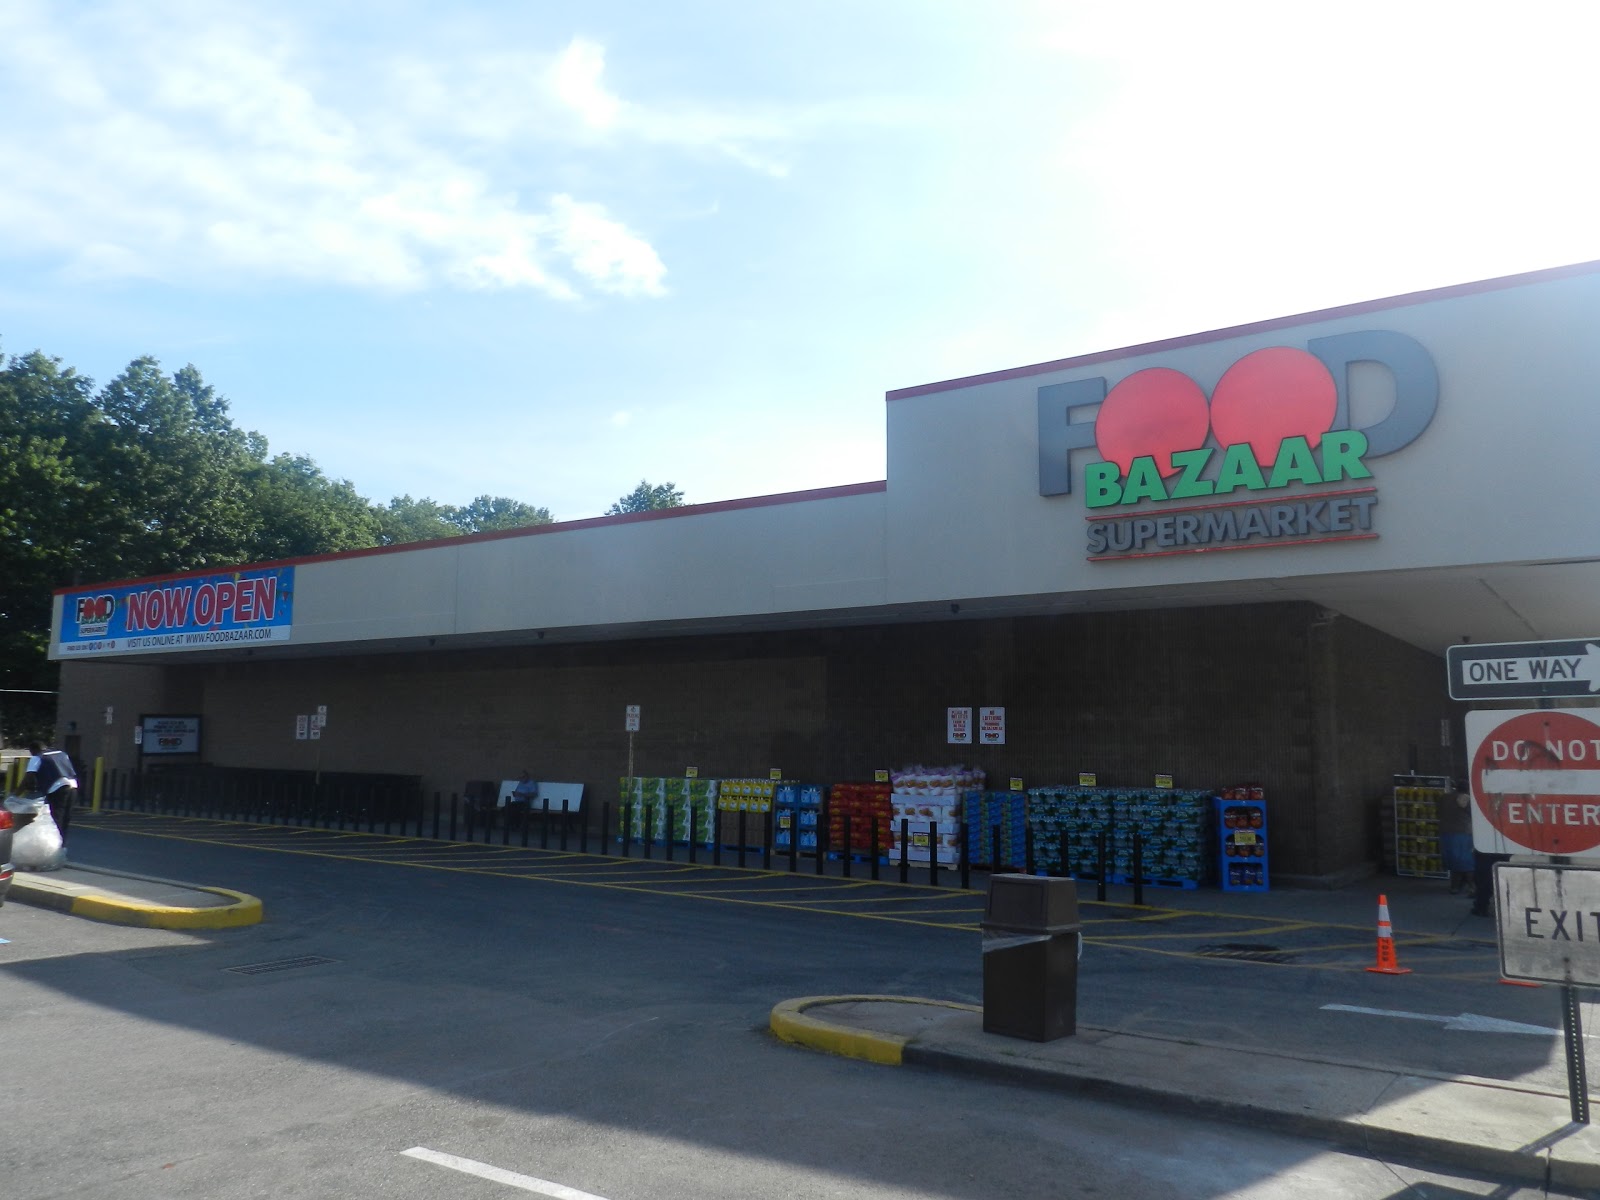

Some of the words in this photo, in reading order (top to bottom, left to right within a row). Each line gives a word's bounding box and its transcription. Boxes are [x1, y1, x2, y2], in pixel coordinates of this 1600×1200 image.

[1038, 330, 1440, 497] FOOD
[1084, 429, 1374, 508] BAZAAR
[1086, 497, 1378, 554] SUPERMARKET
[76, 594, 116, 624] FOOD
[126, 586, 192, 632] NOW
[194, 576, 278, 627] OPEN
[127, 638, 142, 648] VISIT
[143, 637, 151, 646] US
[152, 635, 175, 646] ONLINE
[176, 634, 184, 644] AT
[186, 628, 272, 643] WWW.FOODBAZAAR.COM
[1469, 660, 1519, 682] ONE
[1528, 657, 1582, 680] WAY
[1492, 740, 1530, 761] DO
[1545, 739, 1600, 761] NOT
[1508, 803, 1600, 825] ENTER
[1525, 907, 1600, 944] EXIT
